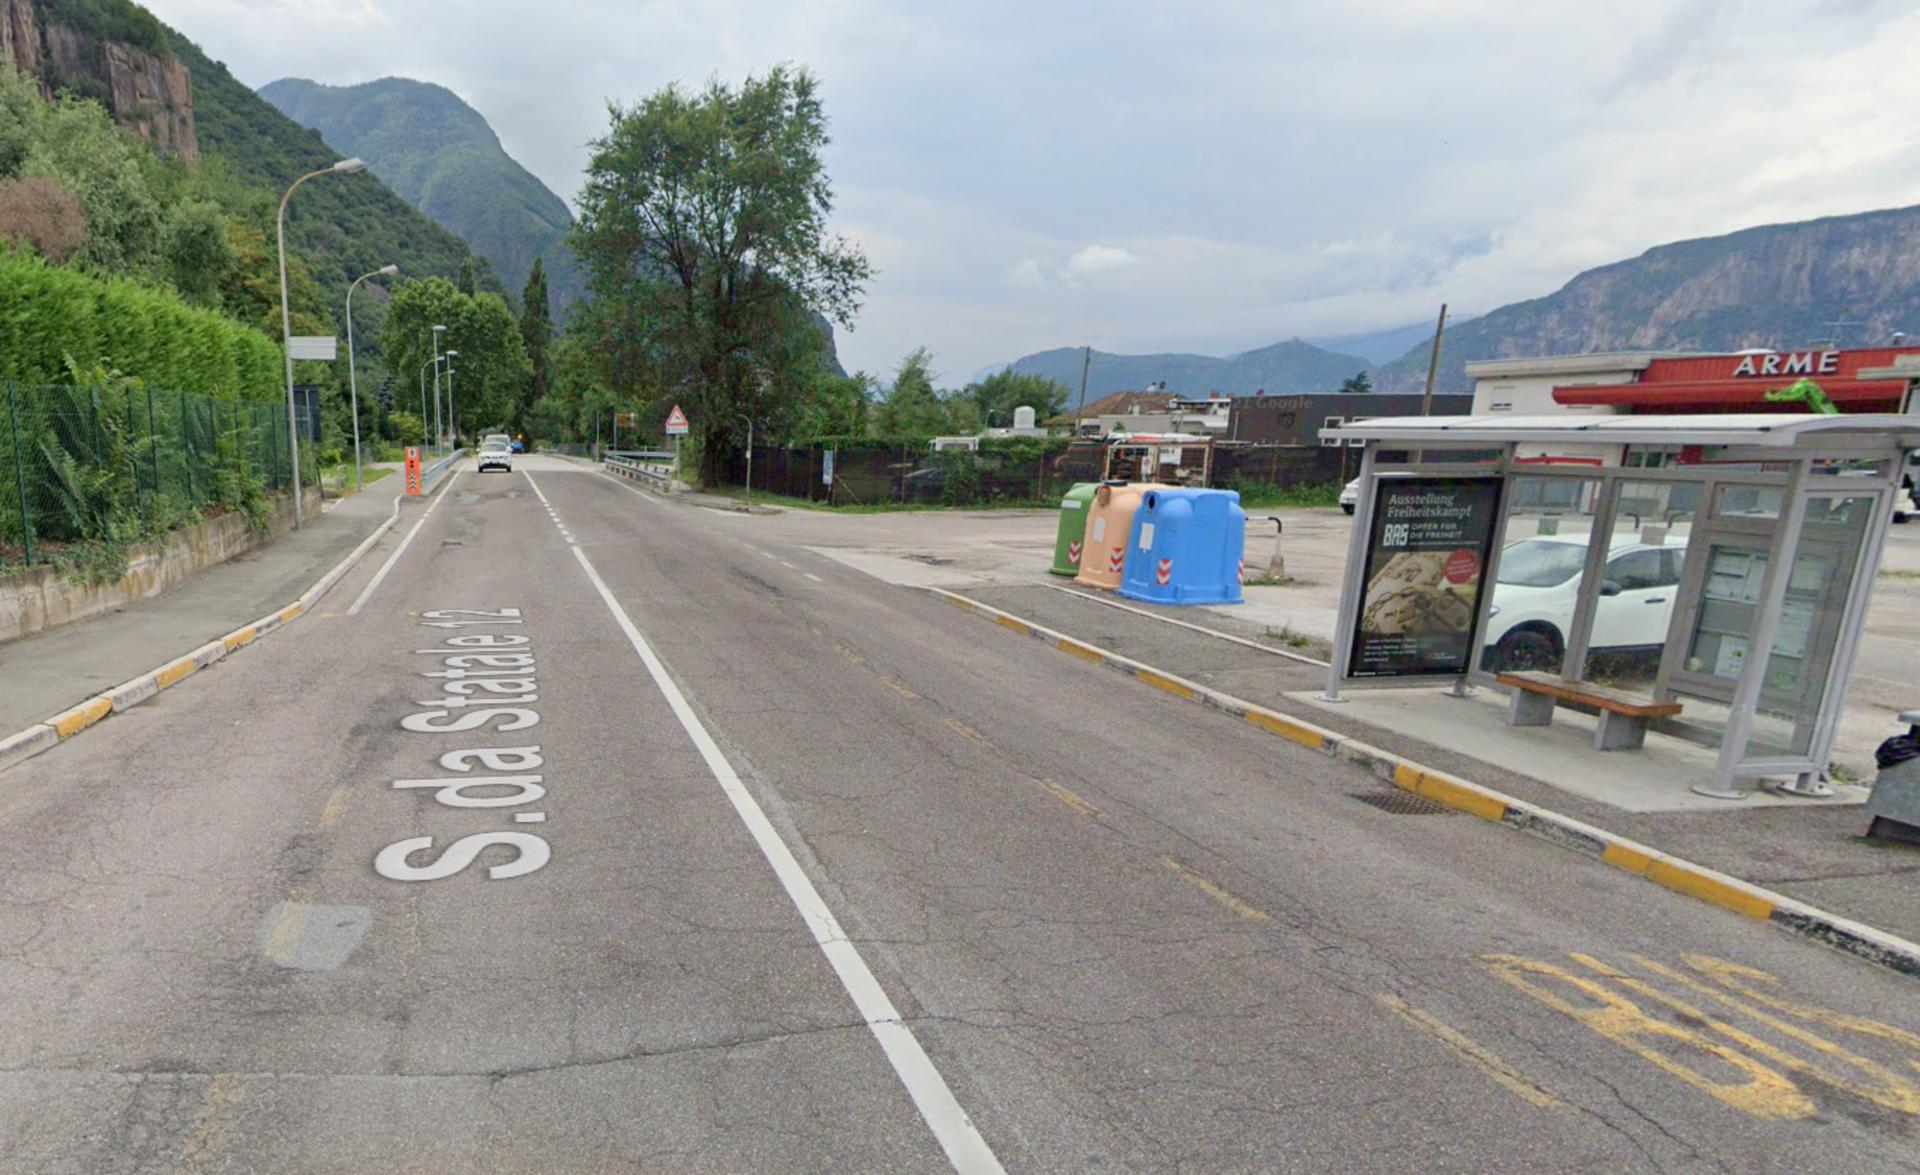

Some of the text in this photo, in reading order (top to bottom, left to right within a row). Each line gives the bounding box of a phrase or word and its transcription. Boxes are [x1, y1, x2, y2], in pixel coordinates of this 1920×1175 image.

[1732, 350, 1840, 377] ARME
[1388, 493, 1455, 507] Ausstellung
[1387, 505, 1473, 520] Freiheitskampf
[1382, 523, 1410, 547] BAS
